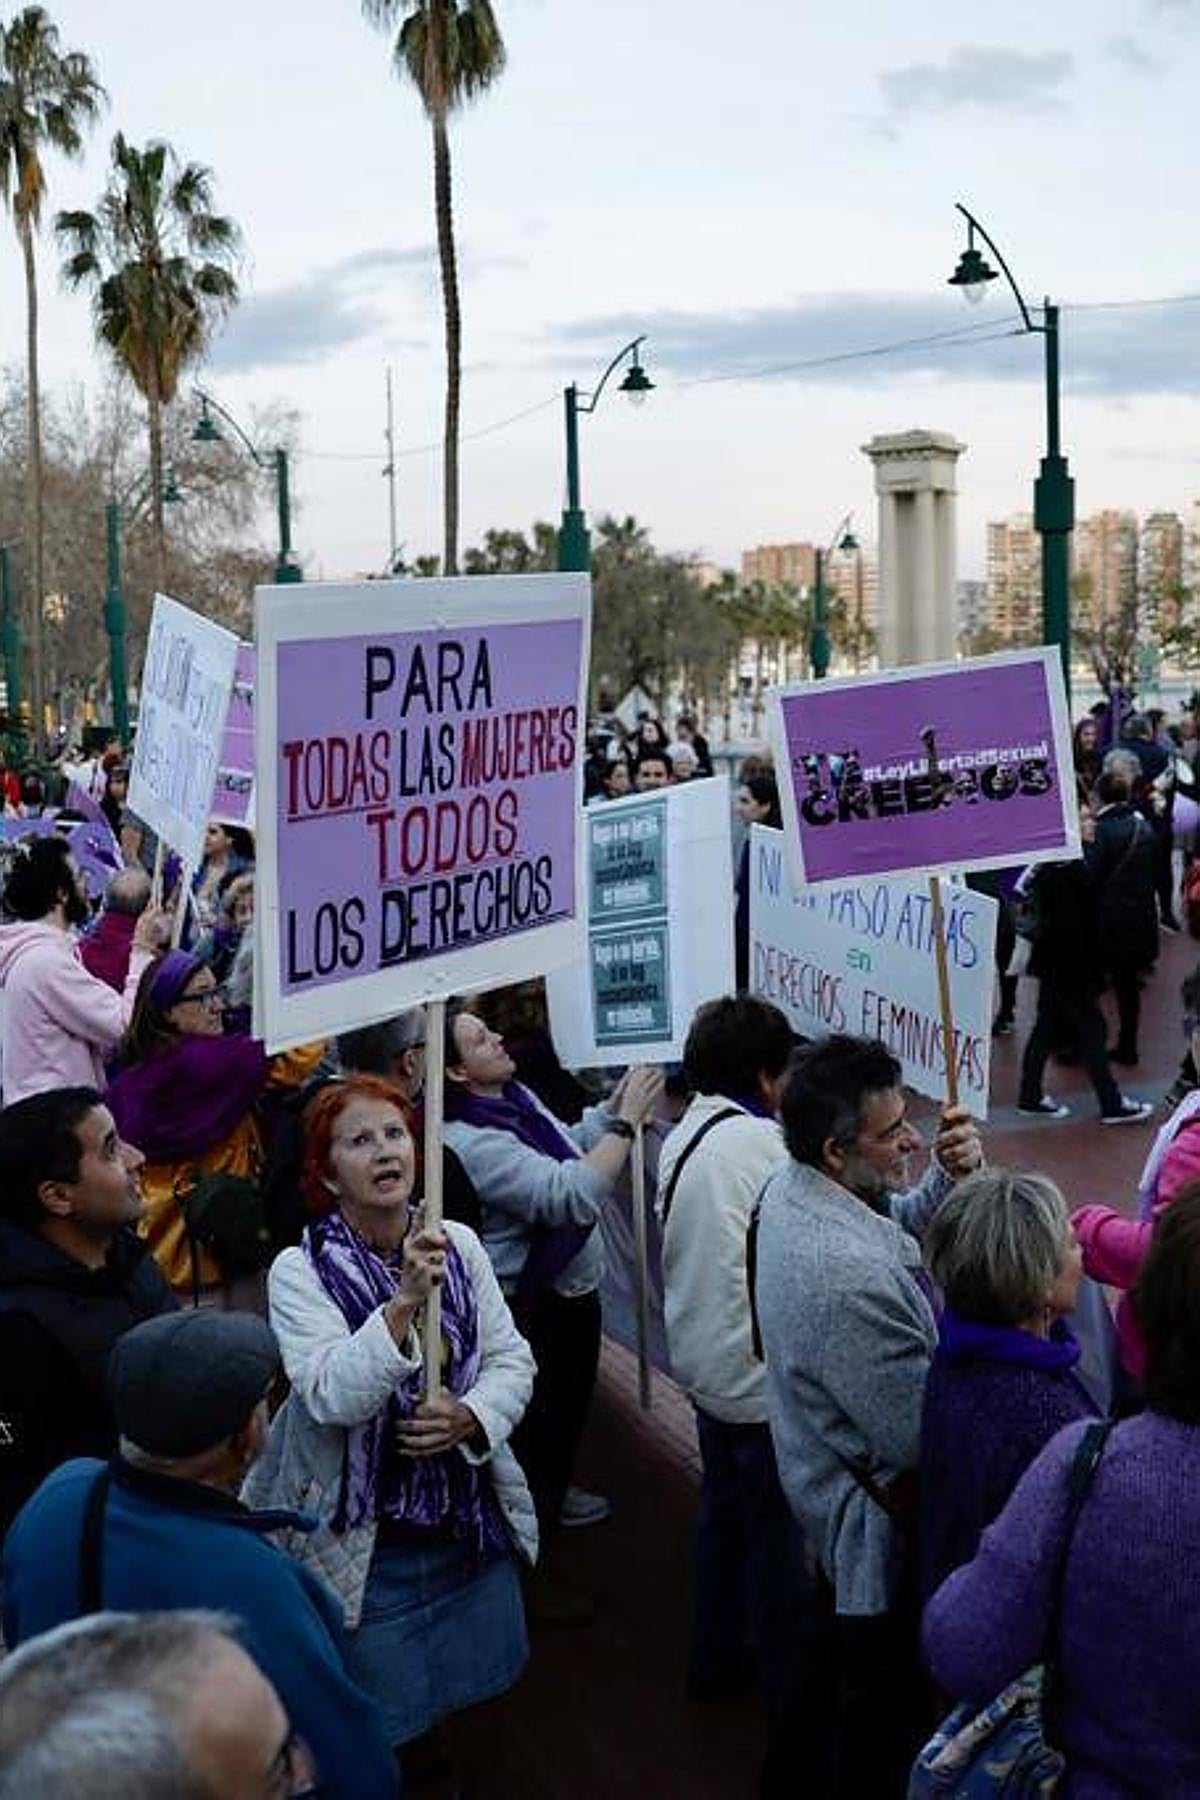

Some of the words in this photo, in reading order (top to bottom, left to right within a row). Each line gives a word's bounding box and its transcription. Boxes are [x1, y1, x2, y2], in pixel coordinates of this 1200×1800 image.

[366, 637, 492, 719] PARA
[283, 730, 391, 817] TODAS
[400, 723, 456, 797] LAS
[459, 704, 578, 789] MUJERES
[367, 789, 518, 884] TODOS
[758, 845, 782, 896] NI
[286, 897, 366, 984] LOS
[380, 855, 554, 964] DERECHOS
[755, 942, 847, 1031] DERECHOS
